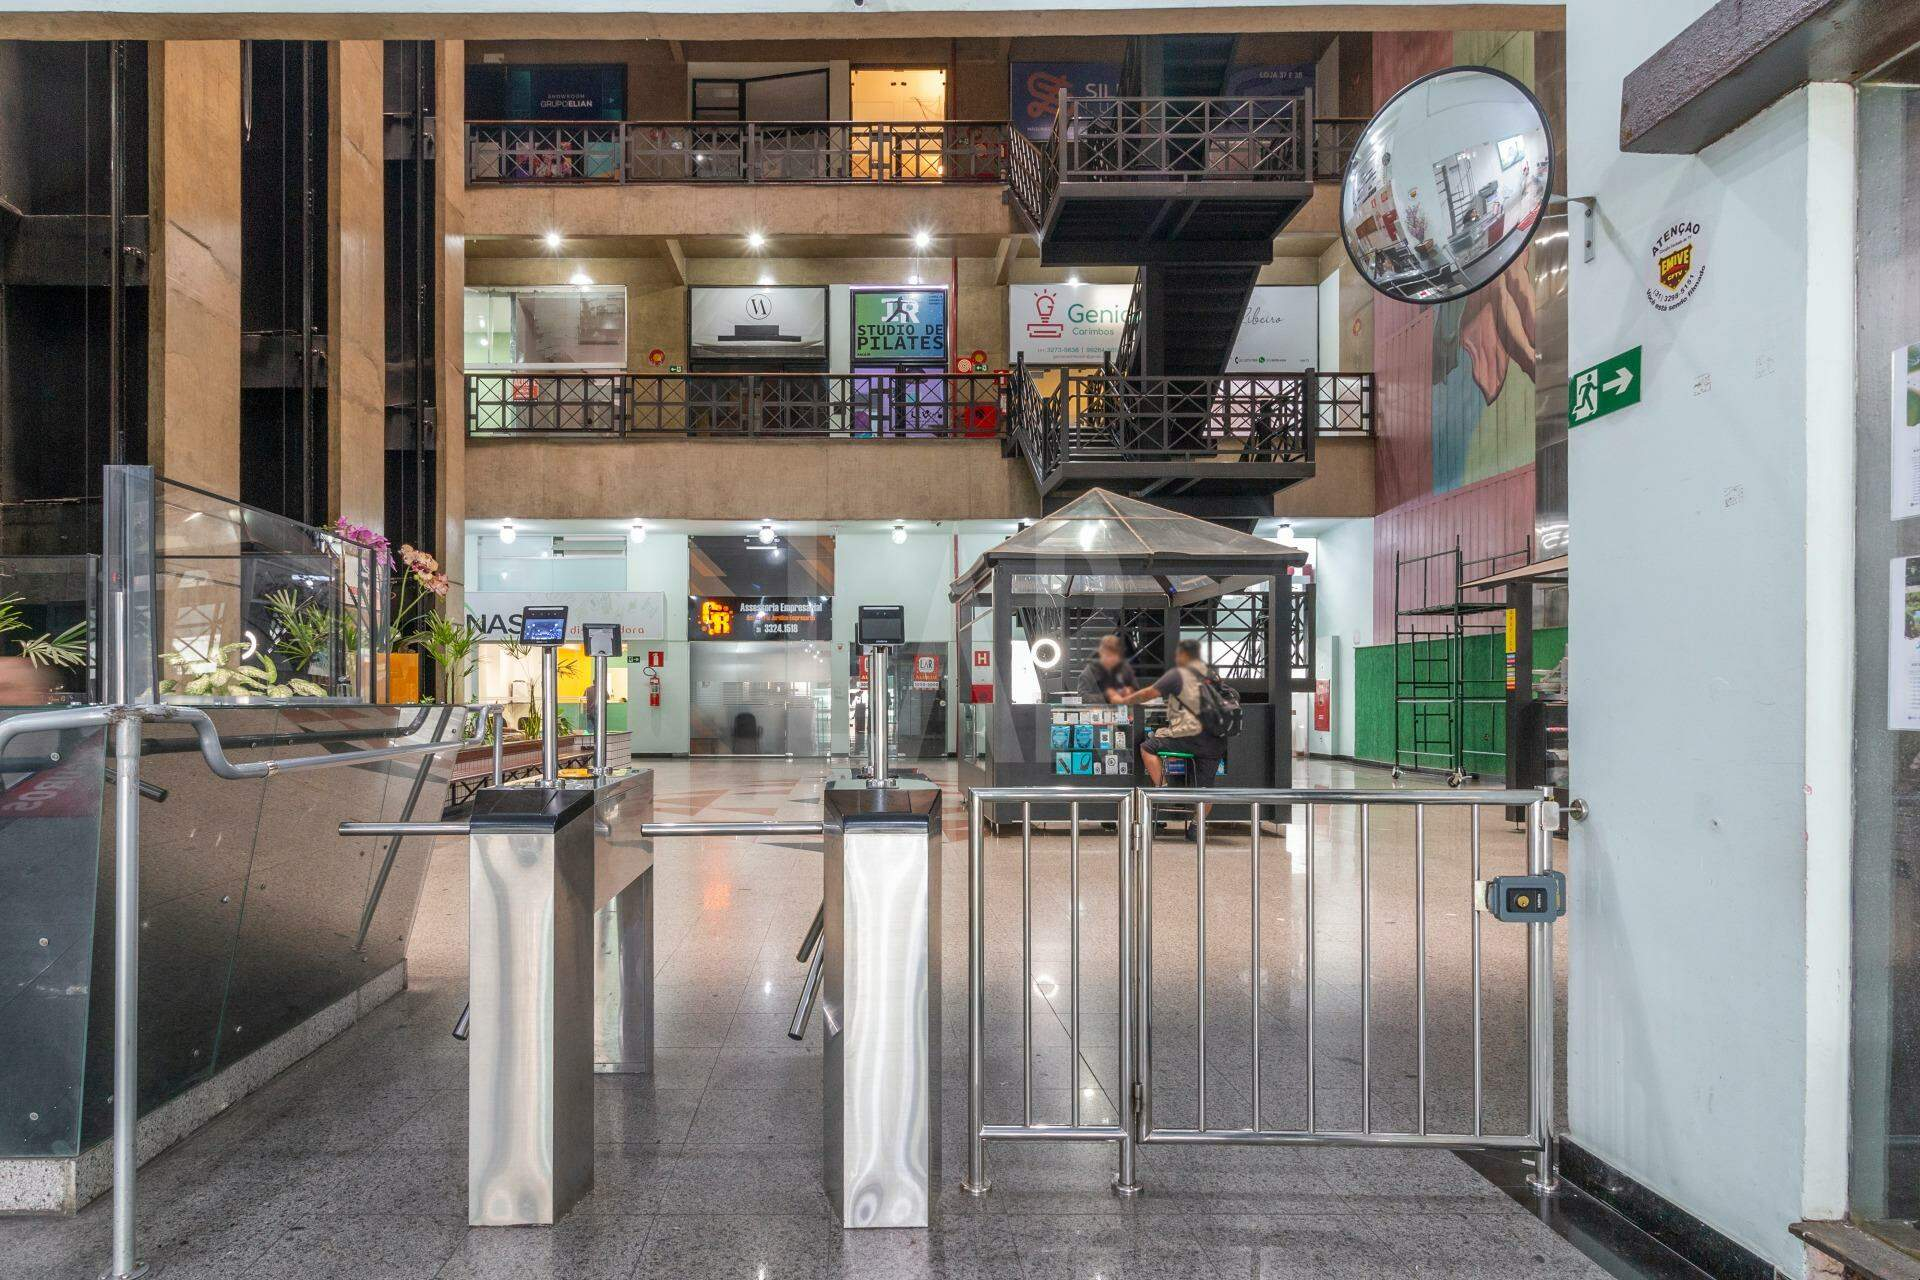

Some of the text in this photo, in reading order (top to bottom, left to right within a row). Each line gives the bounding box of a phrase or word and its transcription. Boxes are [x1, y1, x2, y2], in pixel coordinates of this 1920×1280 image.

[1661, 249, 1690, 276] EMIVE
[1687, 265, 1706, 297] filmado
[857, 324, 943, 336] STUDIO DE
[1072, 327, 1115, 336] Carimbos
[857, 336, 944, 350] PILATES
[764, 624, 799, 633] 3324.1518
[977, 653, 988, 665] H
